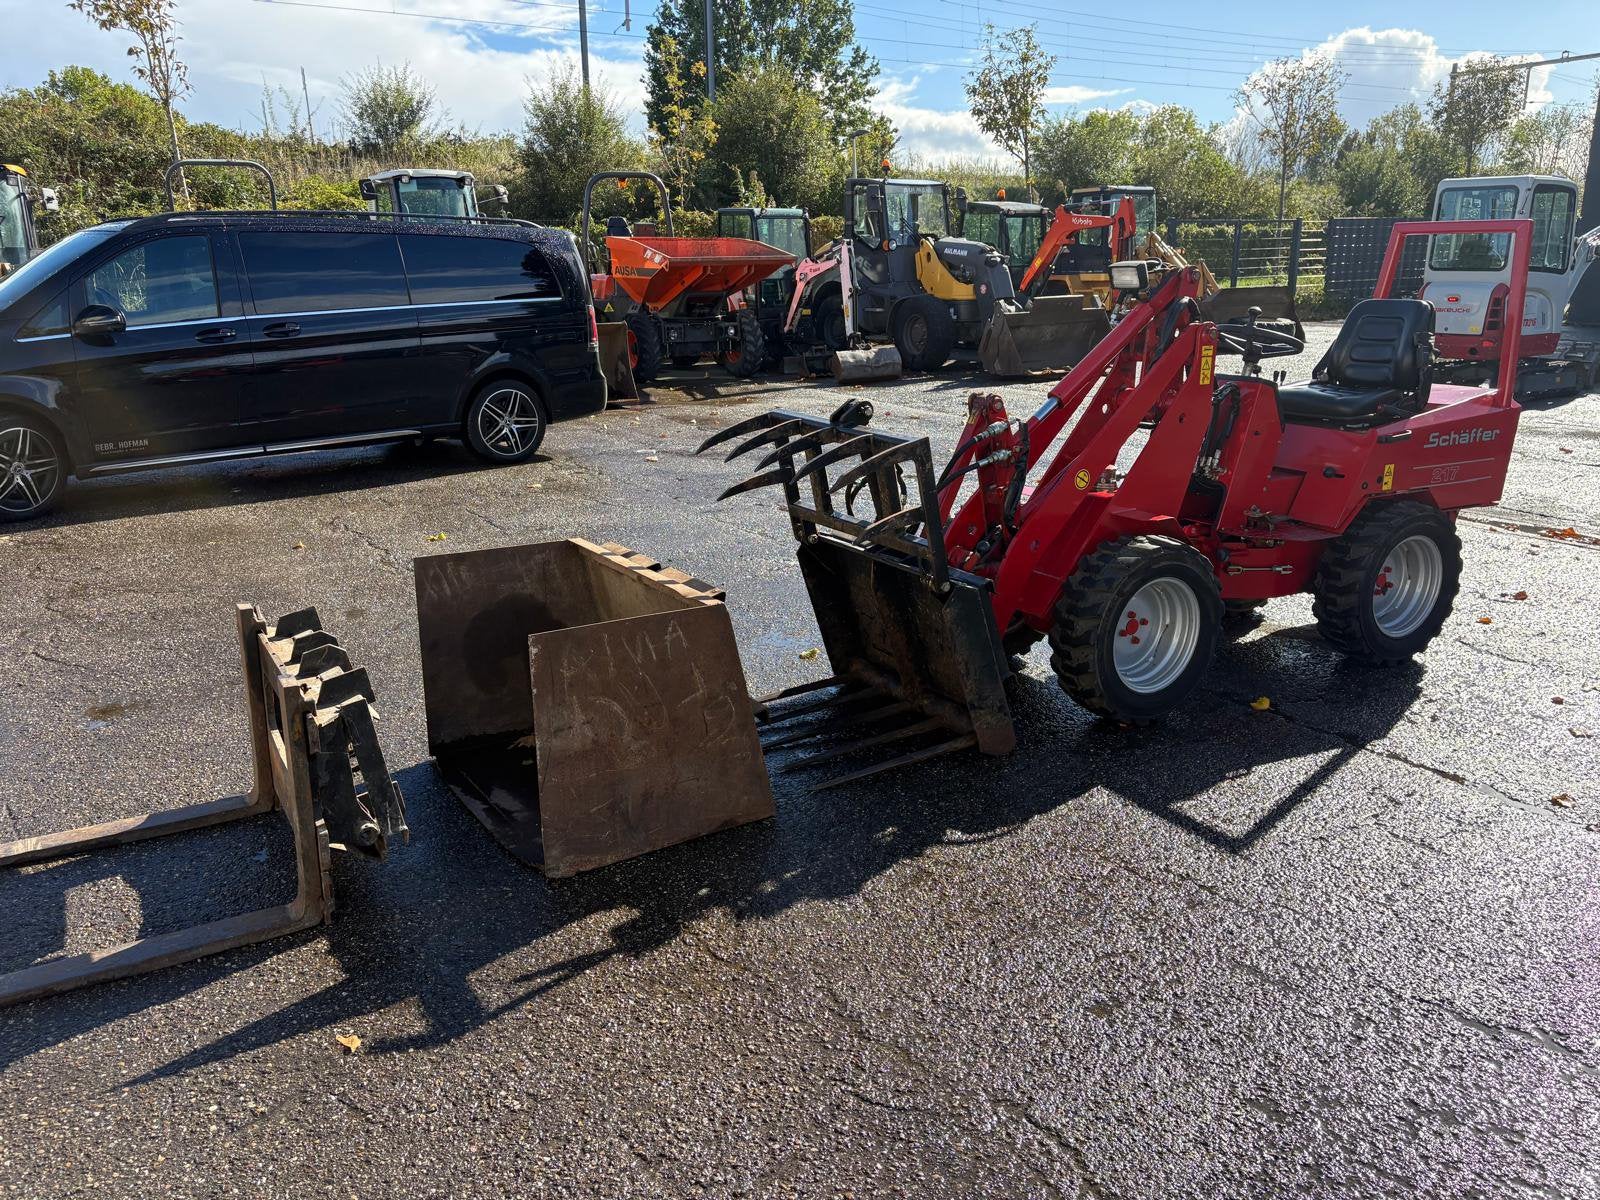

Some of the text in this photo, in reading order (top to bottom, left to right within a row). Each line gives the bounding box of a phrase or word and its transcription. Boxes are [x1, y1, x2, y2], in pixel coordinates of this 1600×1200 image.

[1072, 217, 1093, 226] Kubota
[944, 247, 968, 257] AHLMANN
[615, 265, 636, 276] AUSA
[1423, 427, 1500, 449] Schäffer
[118, 439, 149, 449] HOFMAN
[1430, 465, 1460, 484] 217
